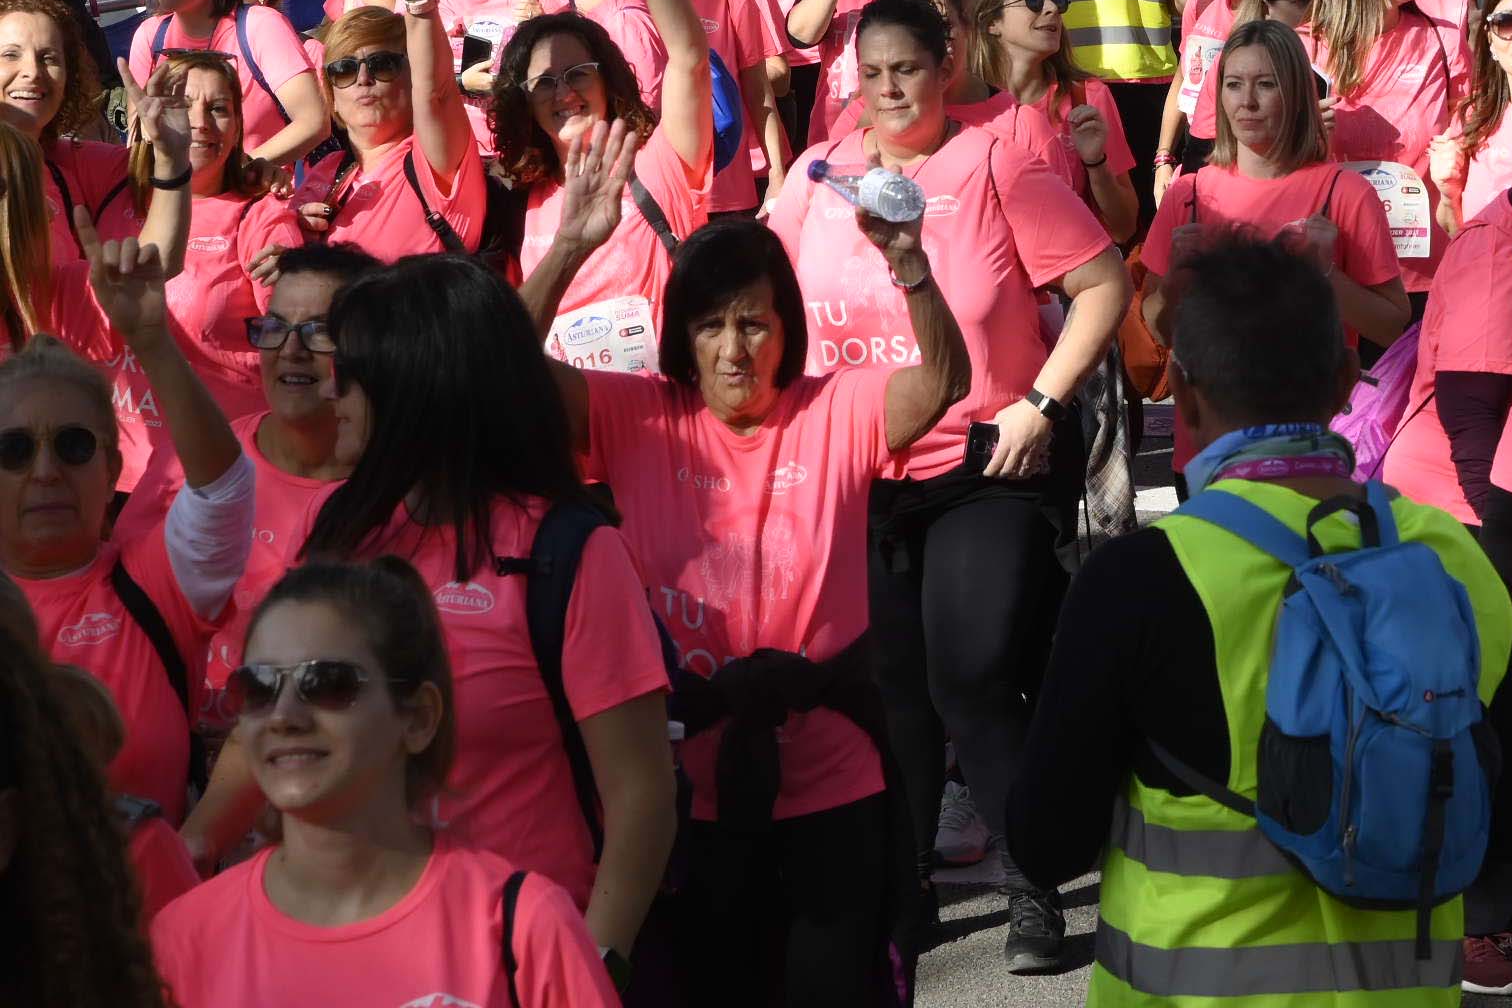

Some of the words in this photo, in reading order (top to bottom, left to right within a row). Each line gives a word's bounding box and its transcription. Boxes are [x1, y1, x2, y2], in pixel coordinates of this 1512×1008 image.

[807, 301, 848, 328] TU
[573, 348, 613, 369] 016
[660, 586, 705, 630] TU
